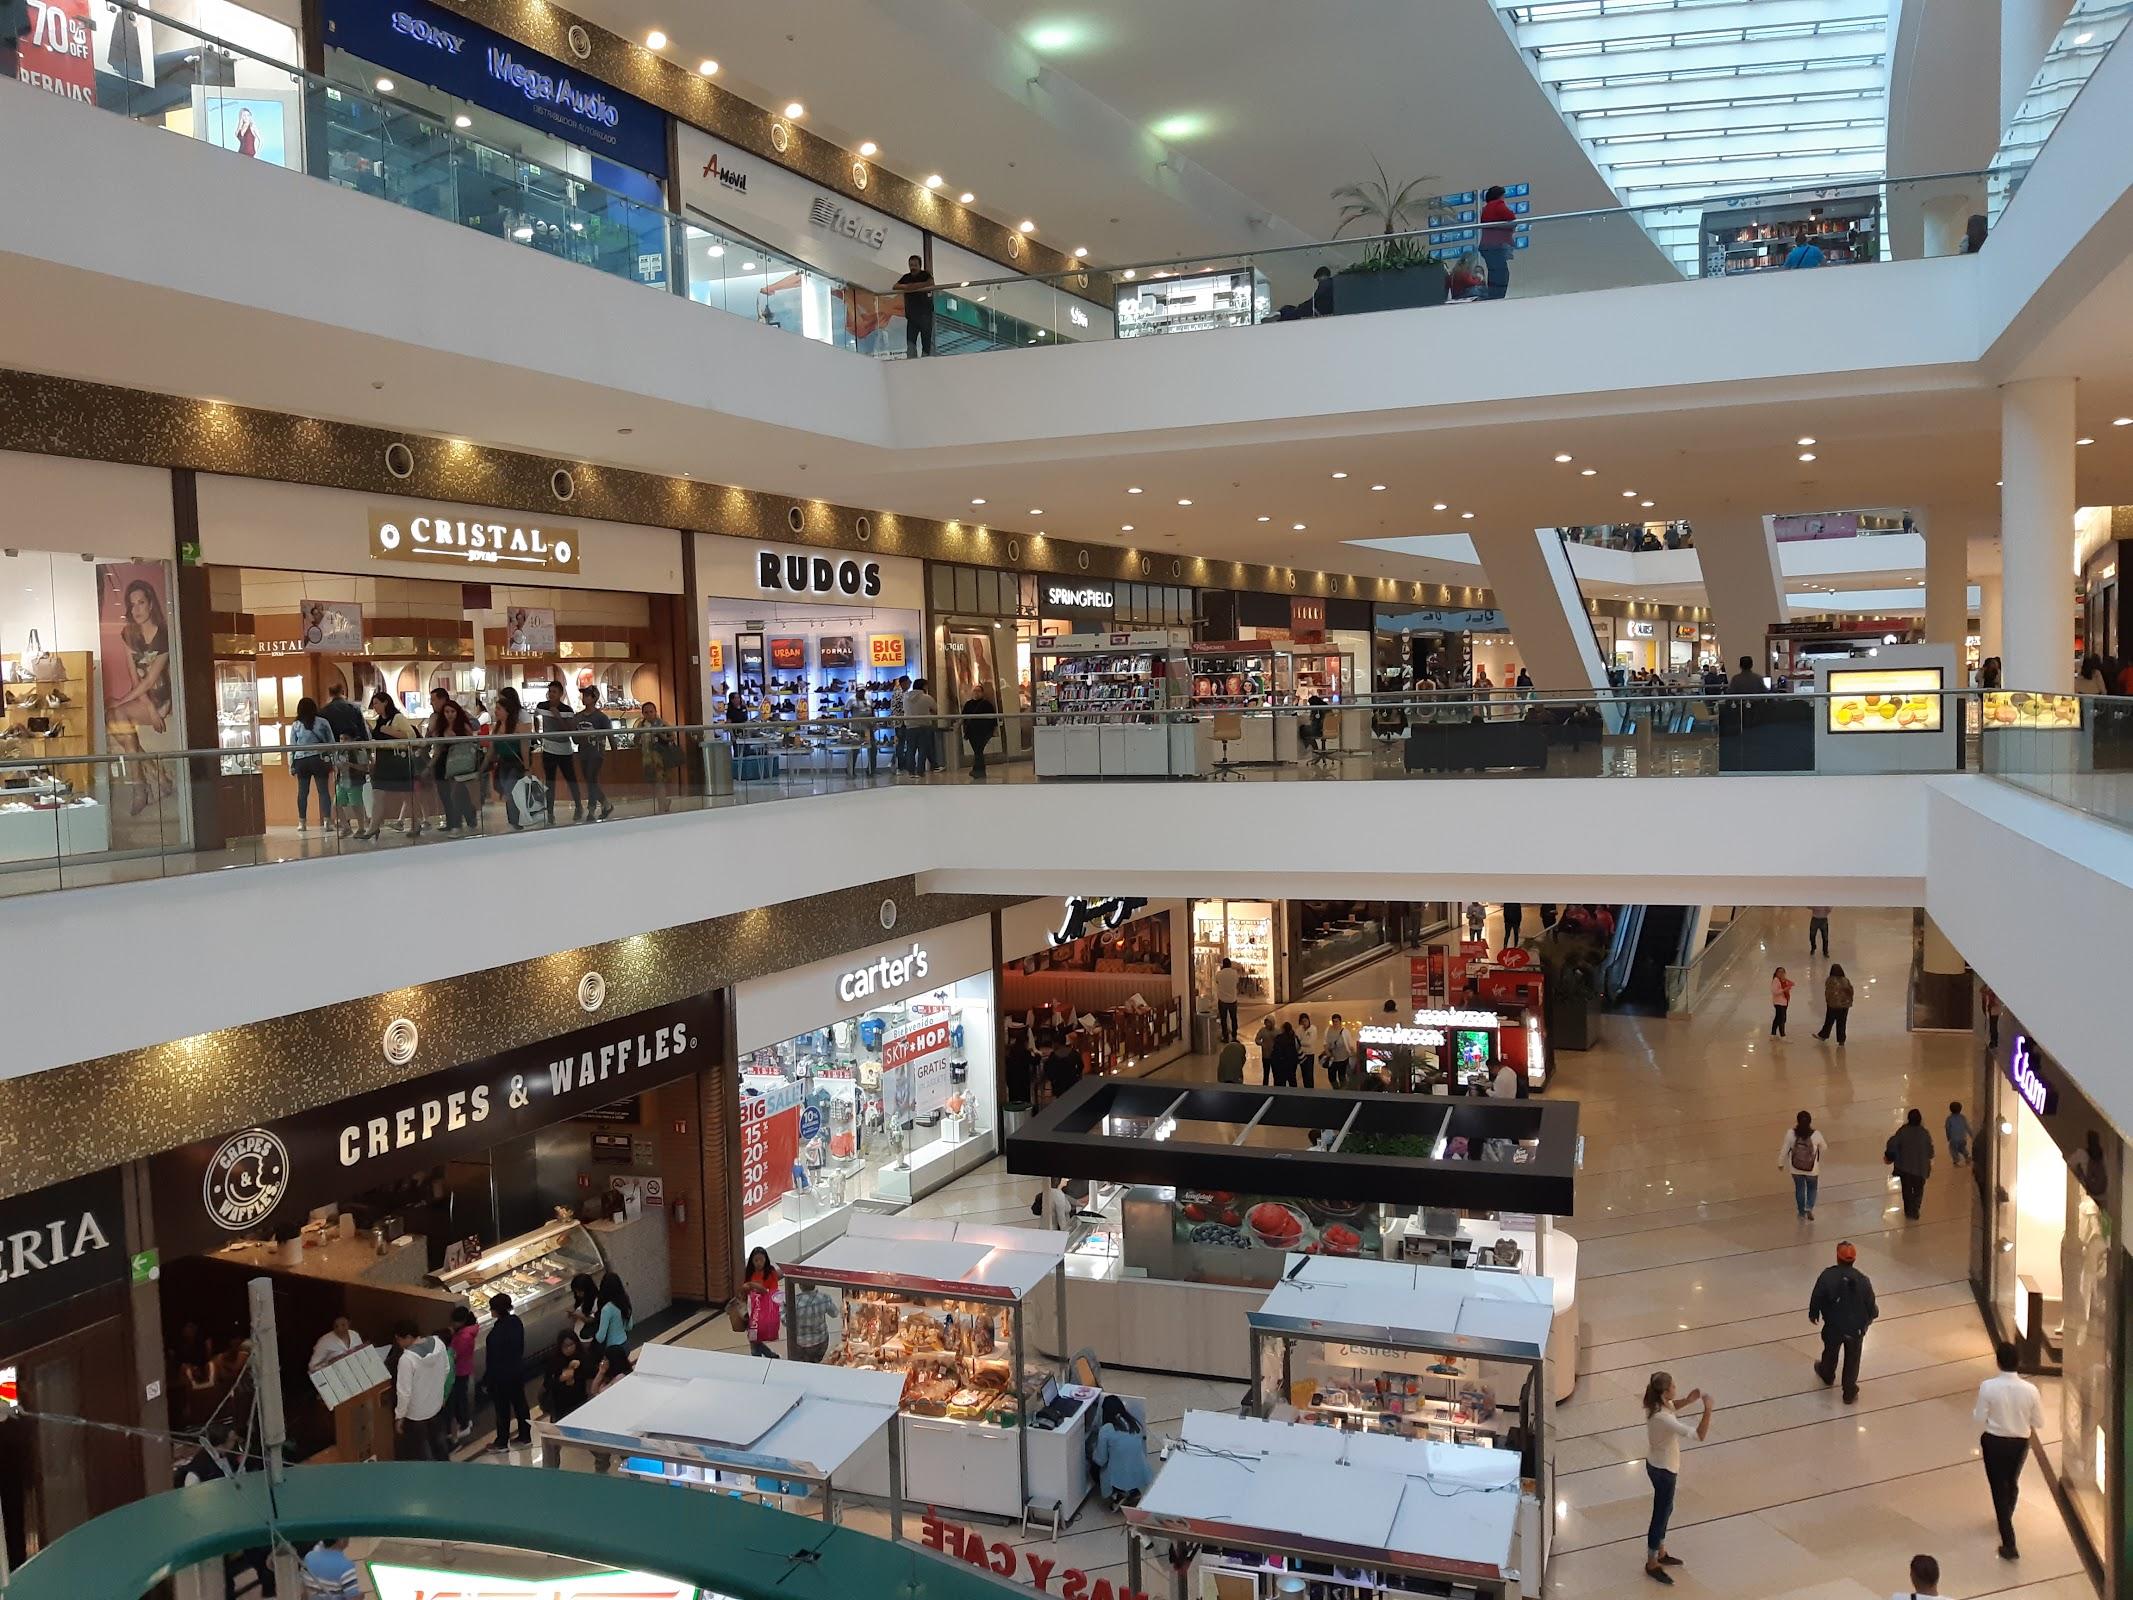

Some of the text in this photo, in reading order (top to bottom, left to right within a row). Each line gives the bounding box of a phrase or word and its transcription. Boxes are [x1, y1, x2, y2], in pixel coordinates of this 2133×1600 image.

[391, 11, 465, 54] SONY
[69, 42, 89, 59] OFF
[487, 47, 619, 127] Mega Audio
[410, 517, 548, 554] CRISTAL
[758, 550, 881, 598] RUDOS
[1048, 587, 1114, 609] SPRINGFIELD
[258, 639, 304, 653] RISTAL
[774, 648, 801, 658] URBAN
[873, 639, 902, 653] BIG
[874, 652, 903, 662] SALE
[840, 943, 929, 1002] carter's
[893, 1017, 934, 1039] Bienvenido
[917, 1057, 947, 1079] GRATIS
[2014, 1035, 2047, 1115] Etam
[339, 1022, 688, 1167] CREPES & WAFFLES
[740, 1098, 766, 1124] BIG
[219, 1137, 273, 1170] CREPES
[240, 1171, 253, 1188] &
[218, 1183, 279, 1222] WAFFLES
